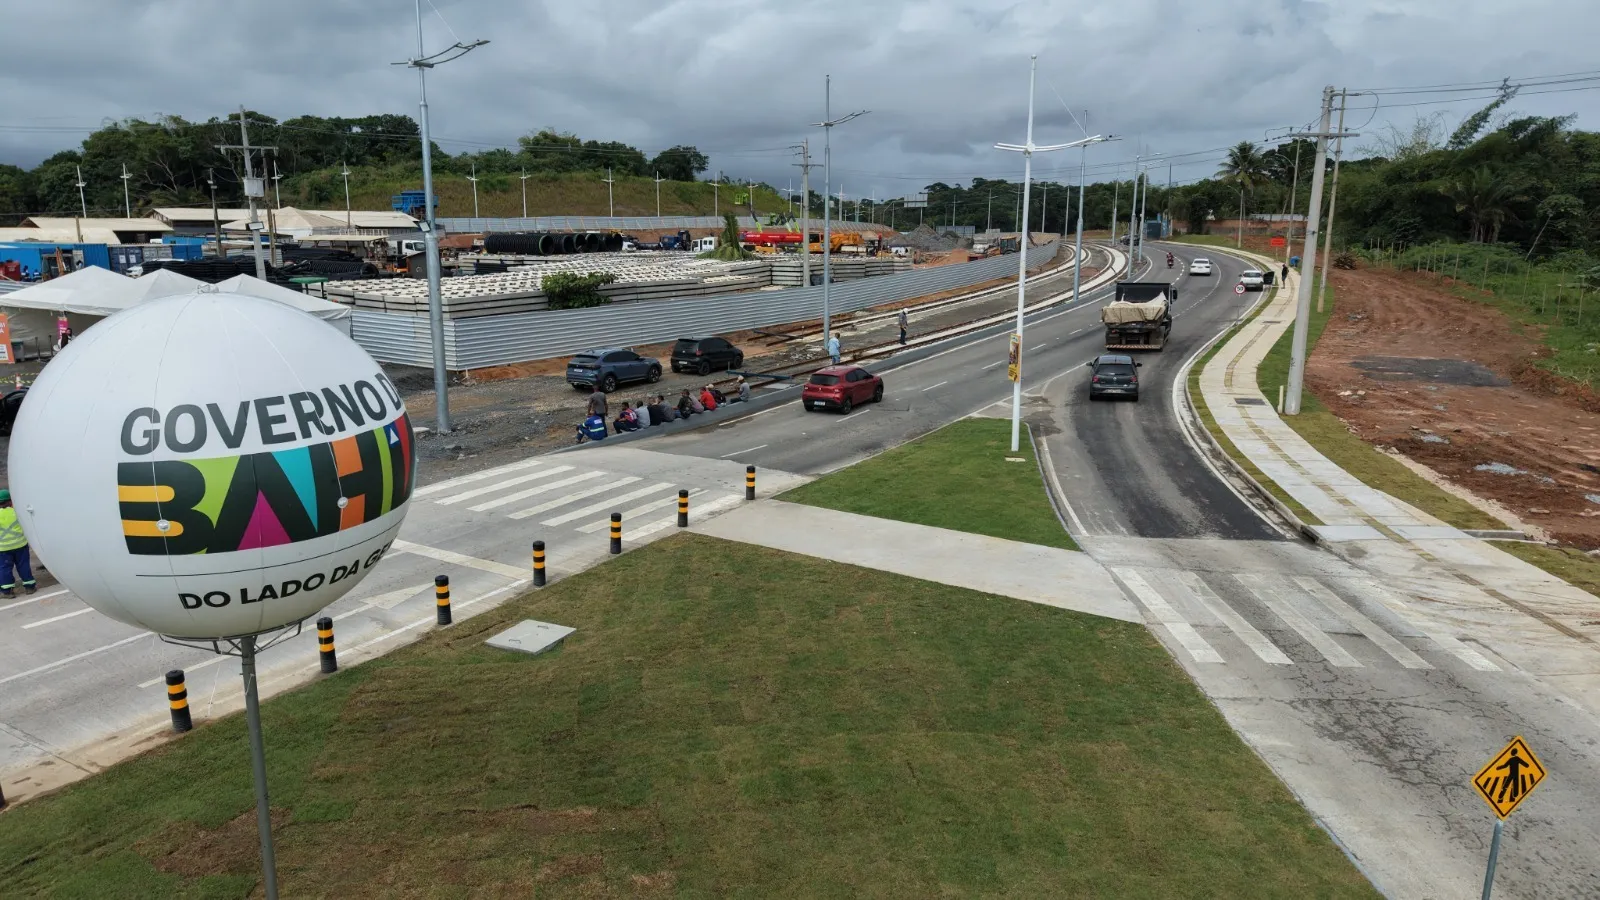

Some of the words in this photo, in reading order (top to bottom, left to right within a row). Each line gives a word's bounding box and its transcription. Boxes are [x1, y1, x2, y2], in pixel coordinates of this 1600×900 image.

[120, 380, 387, 456] GOVERNO
[117, 411, 415, 555] BAHI
[178, 590, 231, 610] DO
[240, 573, 326, 605] LADO
[329, 559, 360, 585] DA
